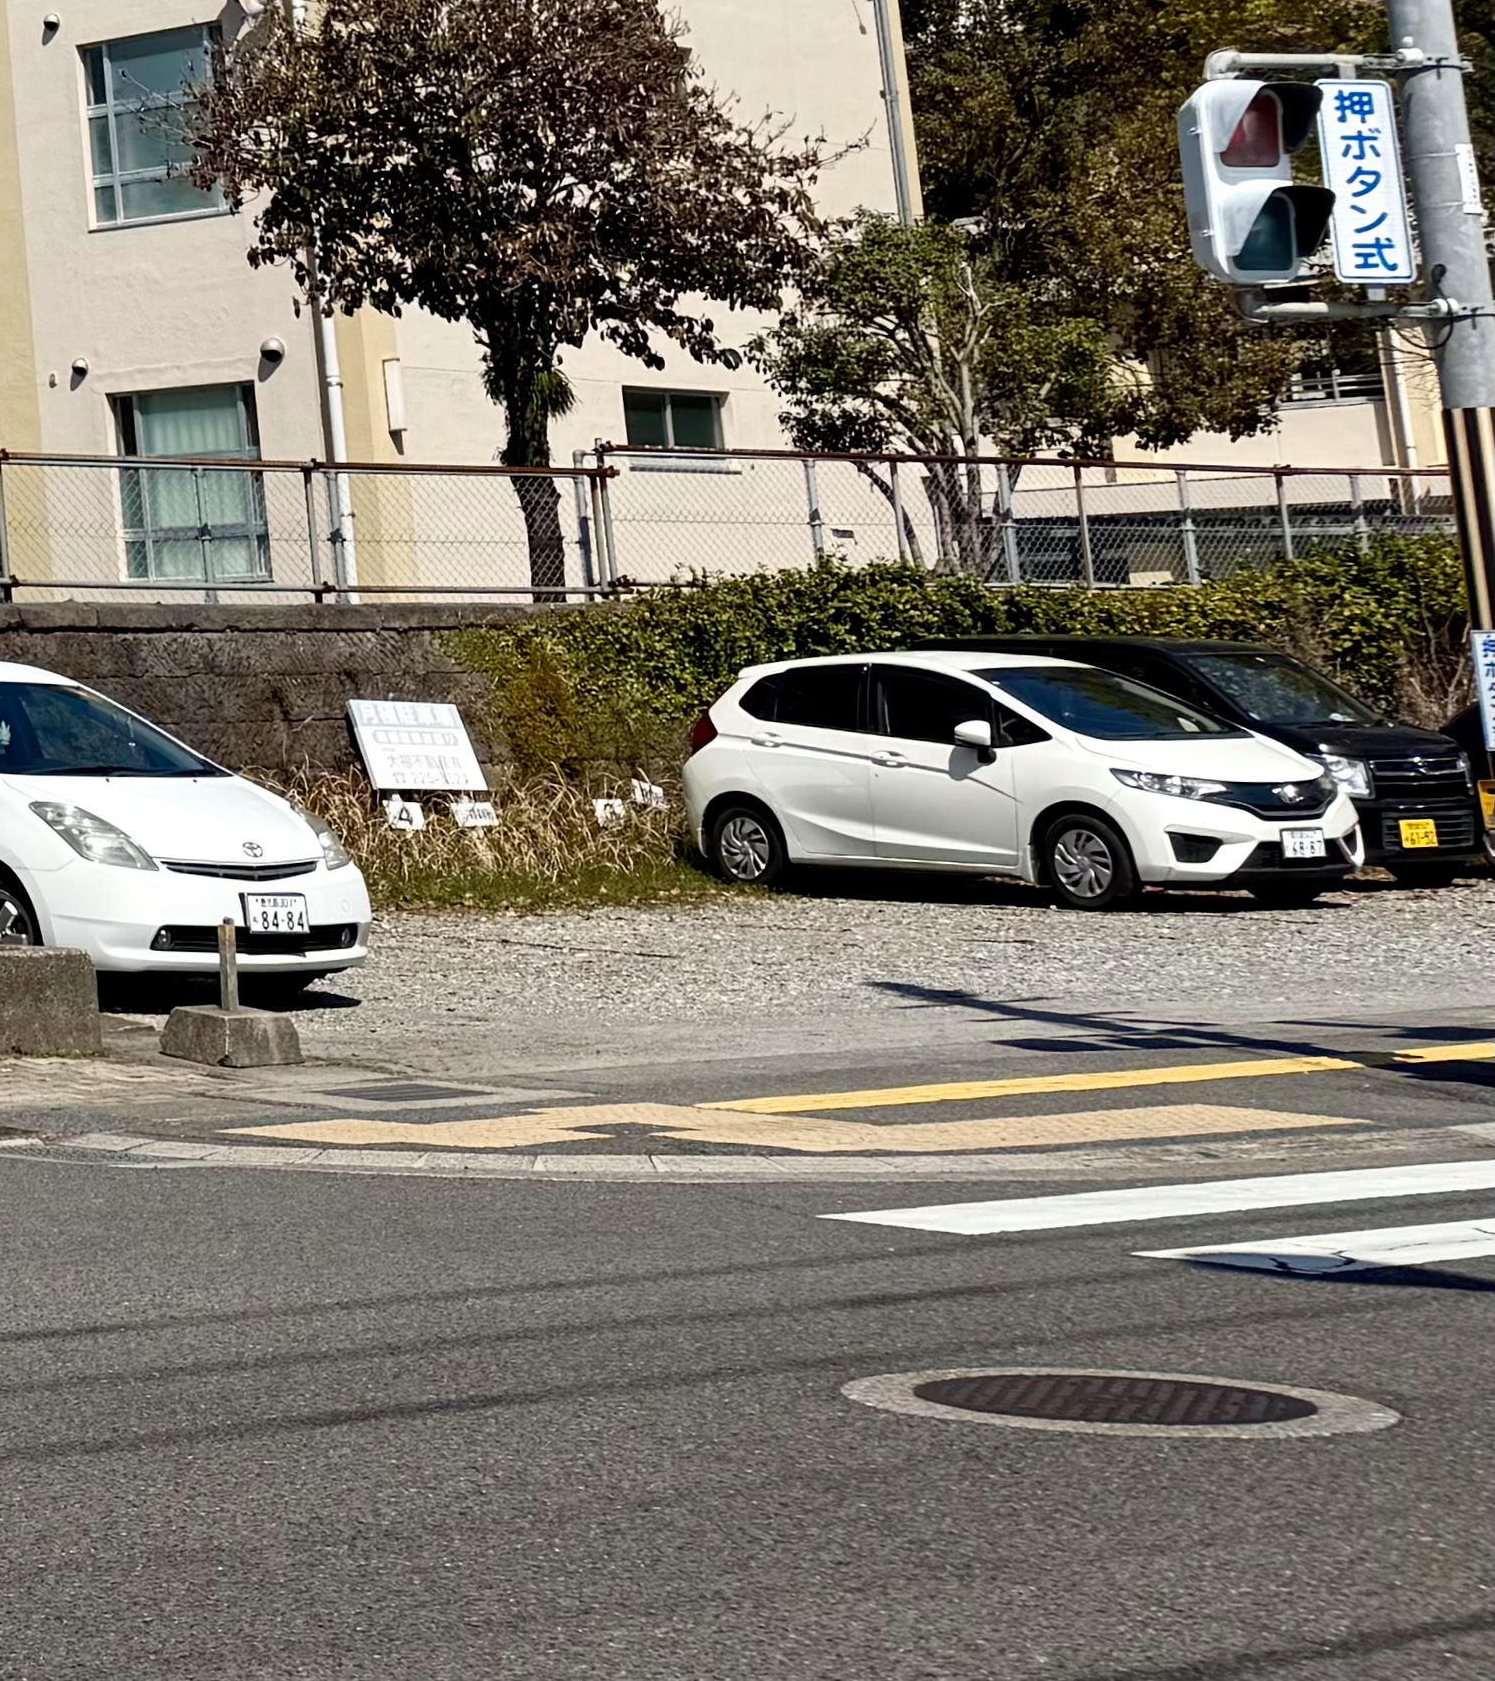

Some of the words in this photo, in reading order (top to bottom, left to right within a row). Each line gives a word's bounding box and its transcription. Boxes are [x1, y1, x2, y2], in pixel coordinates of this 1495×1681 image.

[1334, 88, 1399, 272] 押ボタン式
[261, 910, 305, 931] 84-84
